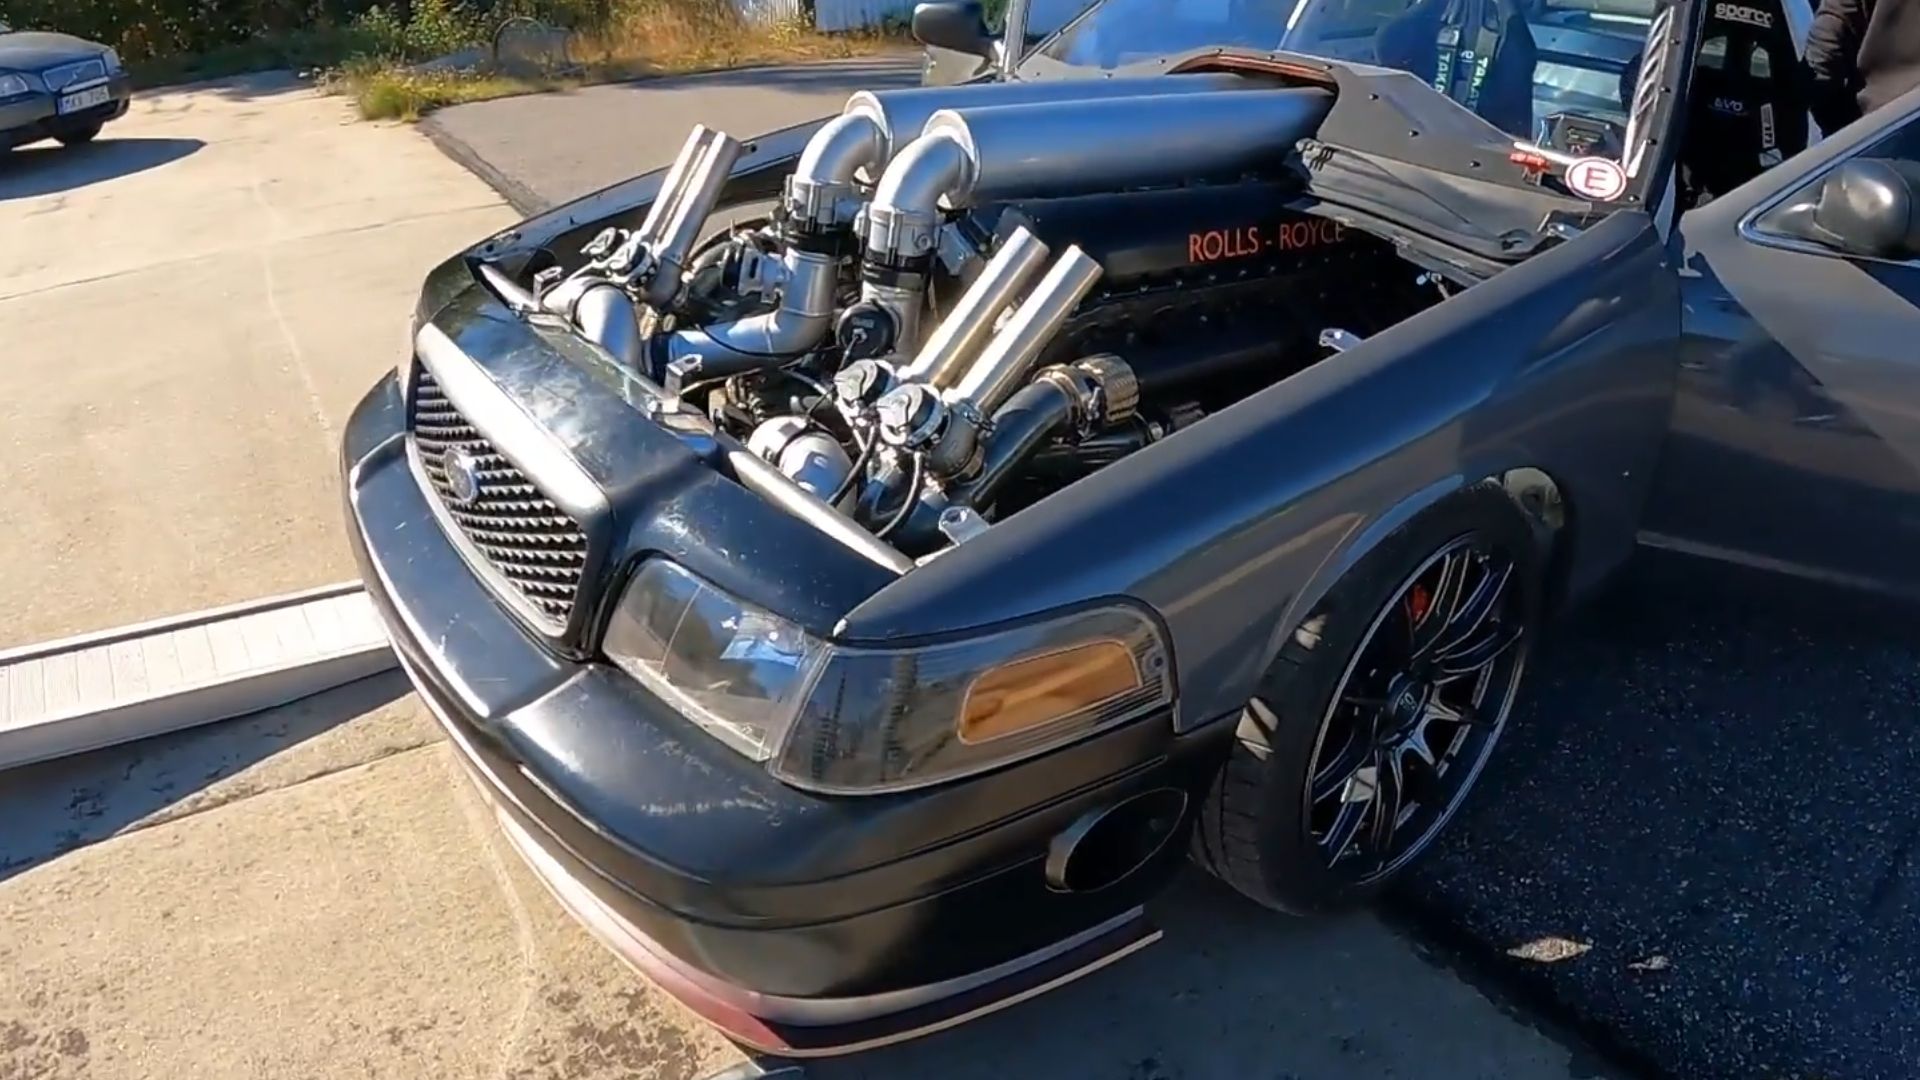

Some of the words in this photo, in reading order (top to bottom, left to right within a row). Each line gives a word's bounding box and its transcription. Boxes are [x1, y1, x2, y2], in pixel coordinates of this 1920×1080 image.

[1584, 167, 1609, 190] E
[1188, 226, 1260, 263] ROLLS
[1278, 219, 1346, 251] ROYCE
